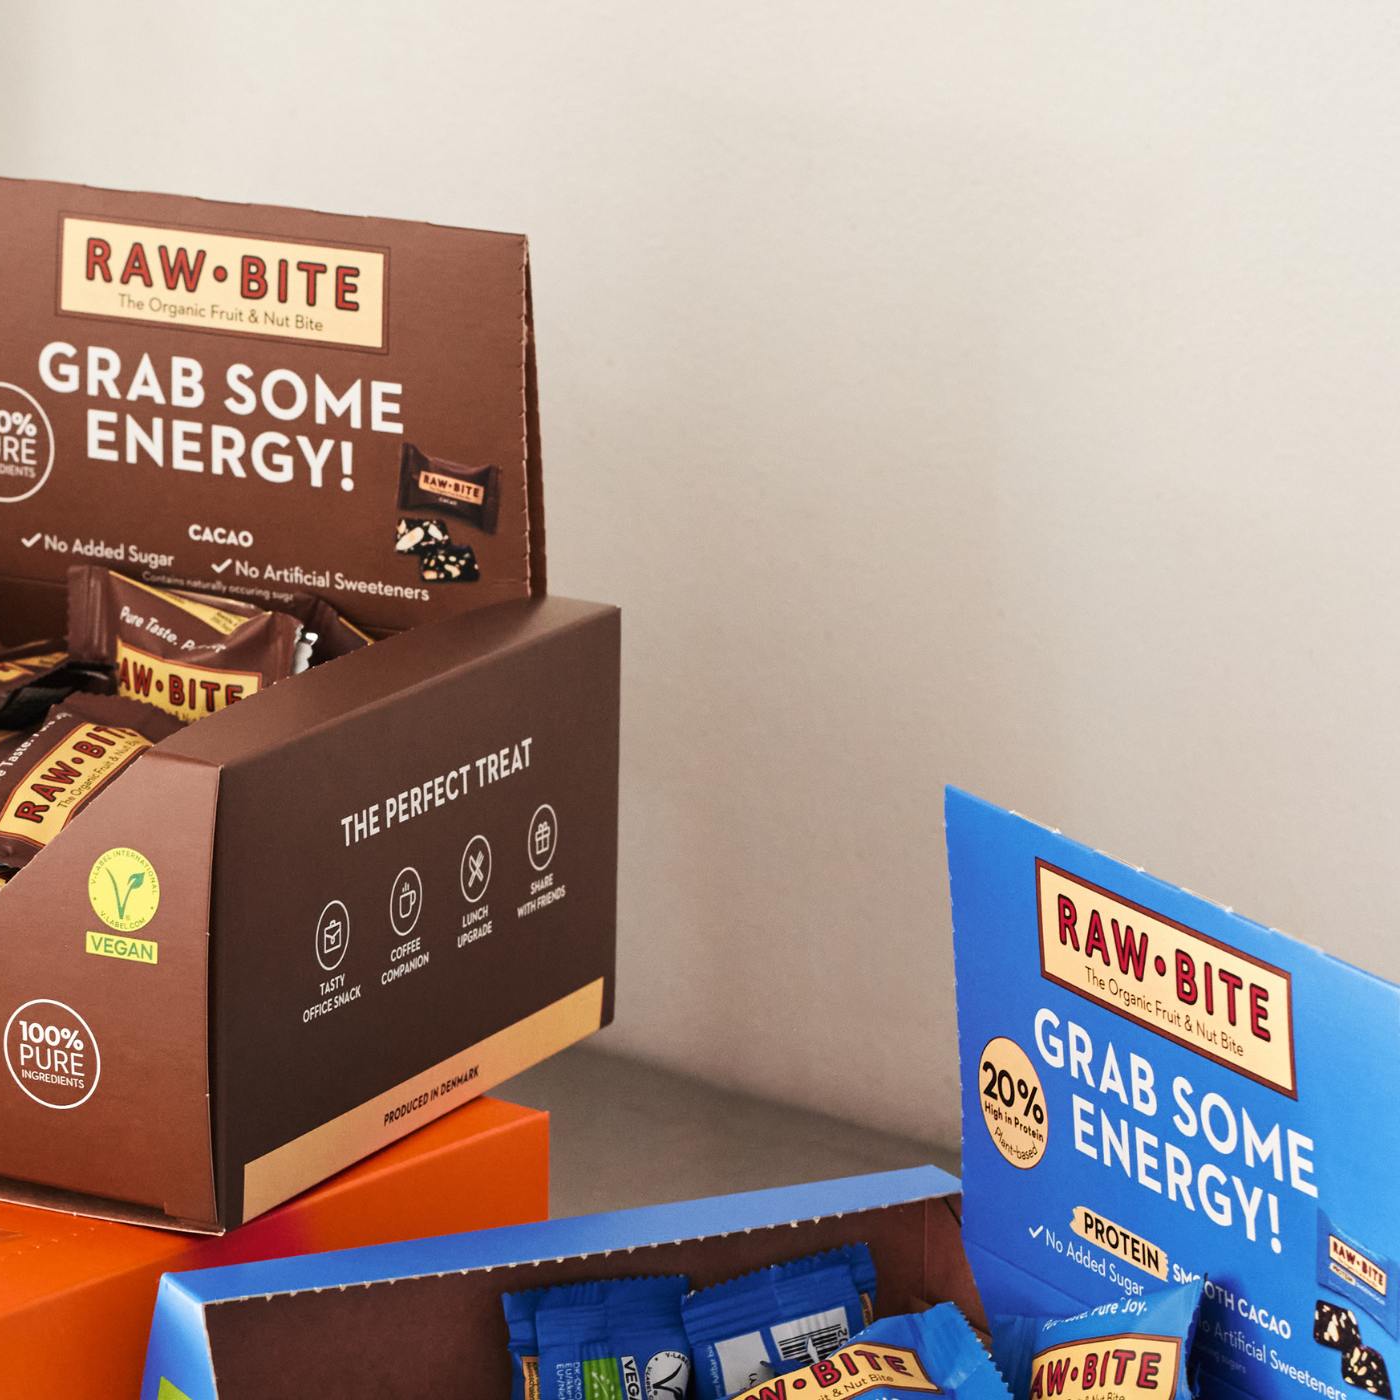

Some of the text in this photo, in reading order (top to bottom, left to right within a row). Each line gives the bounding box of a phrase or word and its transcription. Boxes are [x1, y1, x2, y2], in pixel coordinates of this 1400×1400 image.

[118, 293, 323, 332] The Organic Fruit & Nut Bite
[38, 341, 404, 434] GRAB SOME
[86, 409, 354, 492] ENERGY!
[44, 534, 175, 569] No Added Sugar
[188, 524, 253, 548] CACAO
[142, 570, 185, 586] Contains
[186, 578, 227, 595] naturally
[235, 560, 430, 601] No Artificial Sweeteners
[120, 605, 144, 629] Pure
[149, 617, 178, 646] Taste.
[0, 737, 35, 768] Taste.
[56, 794, 75, 810] The
[70, 773, 97, 797] Organic
[94, 755, 113, 775] Fruit
[341, 737, 533, 847] THE PERFECT TREAT
[516, 884, 566, 920] WITH FRIENDS
[530, 873, 554, 896] SHARE
[462, 905, 489, 928] LUNCH
[91, 934, 154, 961] VEGAN
[390, 937, 421, 962] COFFEE
[457, 921, 493, 949] UPGRADE
[319, 973, 345, 996] TASTY
[380, 952, 430, 985] COMPANION
[302, 985, 362, 1024] OFFICE SNACK
[1085, 965, 1245, 1058] The Organic Fruit & Nut Bite
[18, 1020, 84, 1052] 100%
[19, 1043, 85, 1077] PURE
[21, 1068, 85, 1090] INGREDIENTS
[383, 1065, 480, 1127] PRODUCED IN DENMARK
[982, 1060, 1045, 1125] 20%
[1034, 1007, 1318, 1198] GRAB SOME
[984, 1101, 1044, 1143] High in Protein
[994, 1125, 1038, 1160] Plant-based
[1072, 1093, 1282, 1254] ENERGY!
[1045, 1229, 1145, 1297] No Added Sugar
[1084, 1210, 1160, 1273] PROTEIN
[1237, 1299, 1291, 1340] CACAO
[1121, 1298, 1148, 1316] Joy.
[1214, 1322, 1267, 1364] Artificial
[1270, 1349, 1348, 1400] Sweeteners
[843, 1378, 868, 1393] Nut
[868, 1373, 894, 1382] Bite
